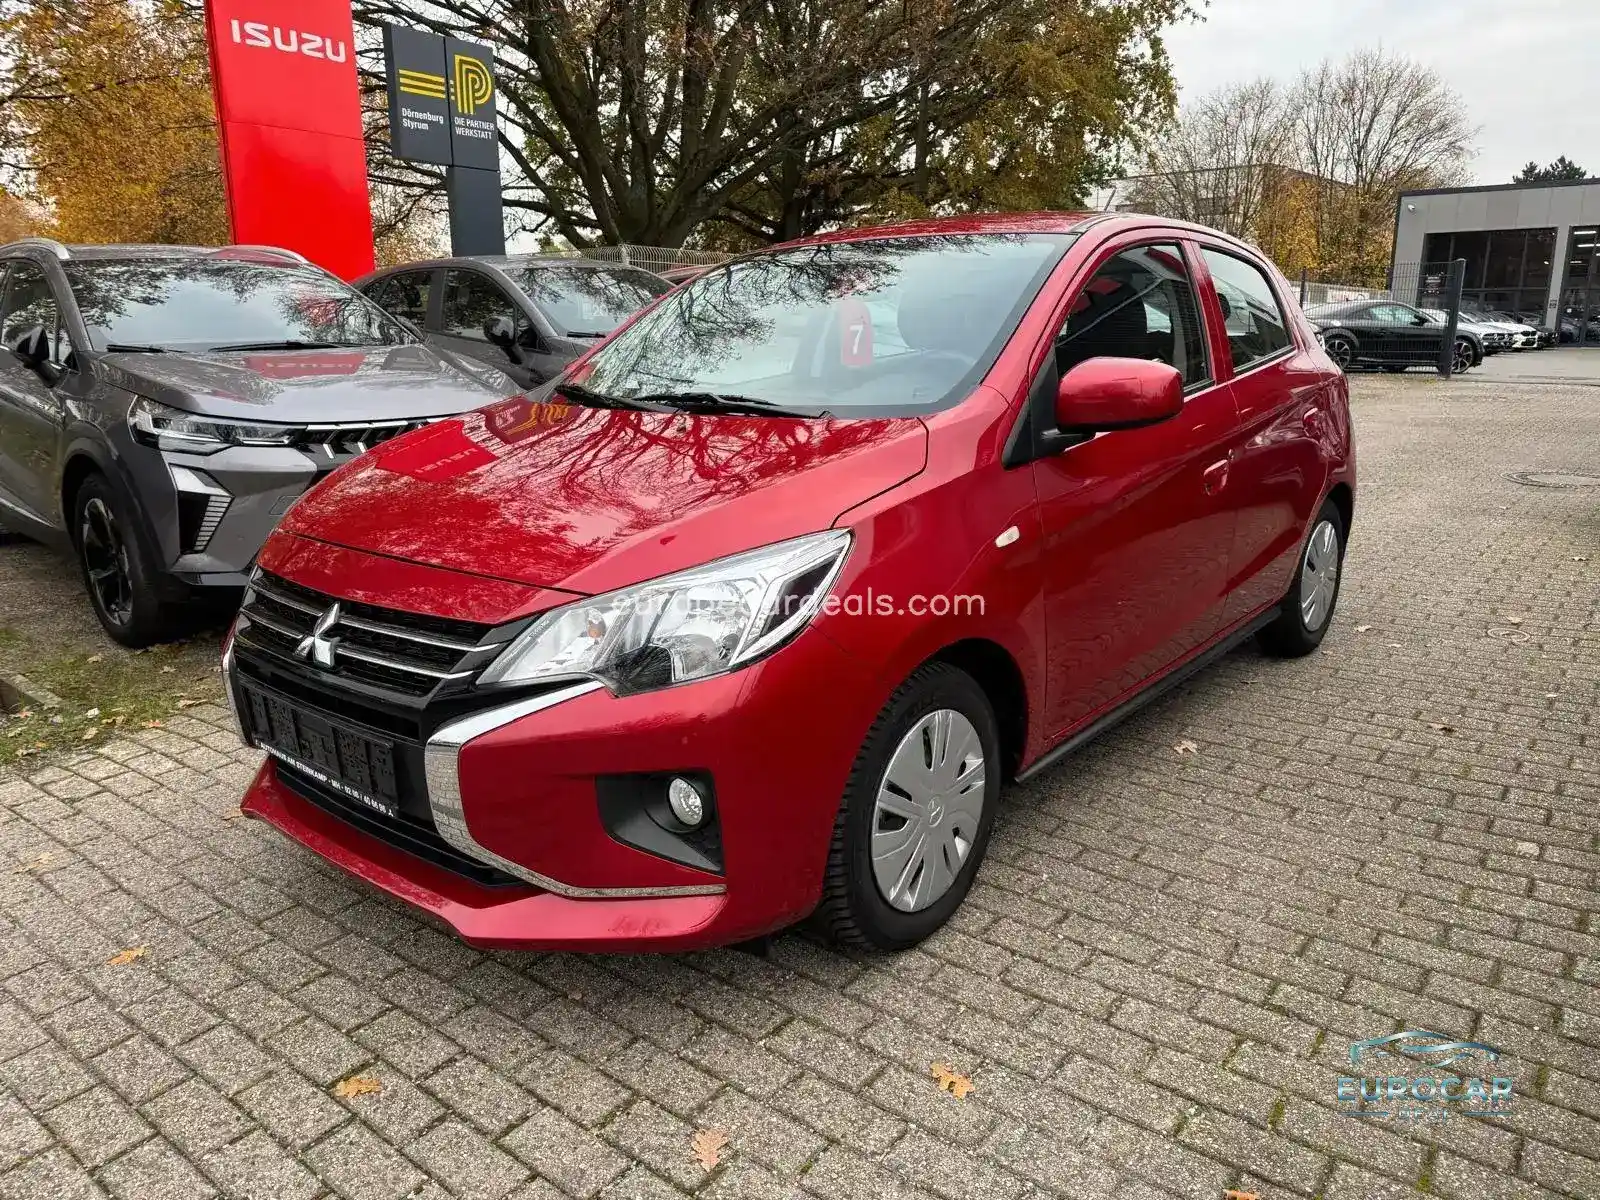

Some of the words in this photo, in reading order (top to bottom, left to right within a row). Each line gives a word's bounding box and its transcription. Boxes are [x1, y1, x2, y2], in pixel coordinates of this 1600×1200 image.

[231, 18, 346, 63] ISUZU
[401, 107, 444, 124] Dörnenburg
[454, 116, 465, 126] DIE
[466, 119, 495, 131] PARTNER
[402, 118, 429, 130] Styrum
[455, 126, 492, 140] WERKSTATT
[849, 324, 864, 355] 7
